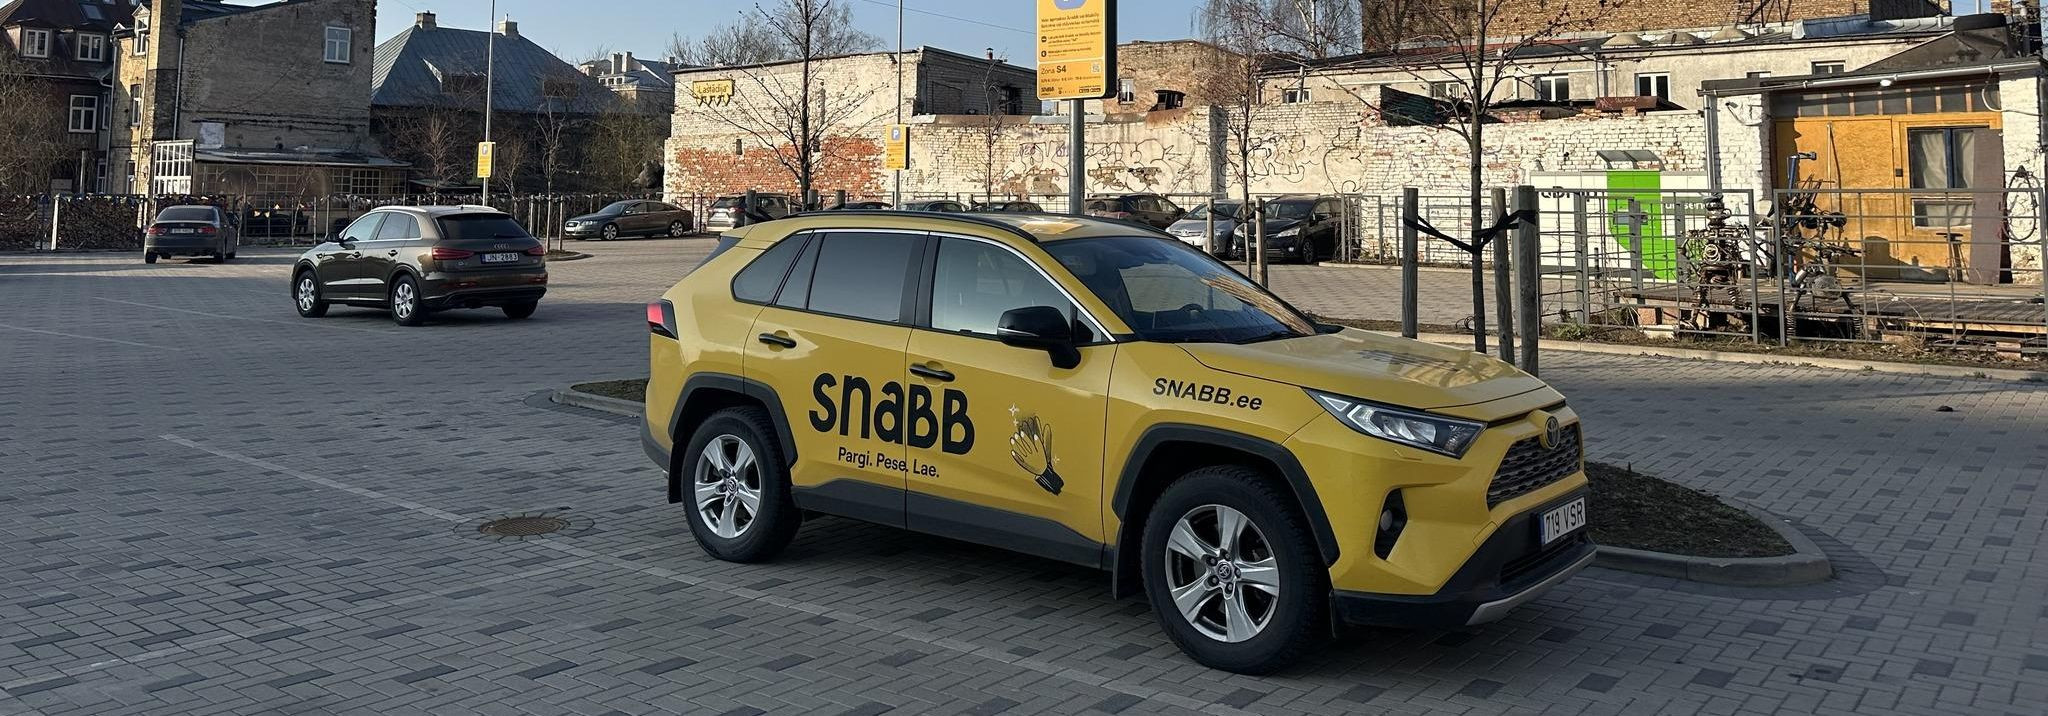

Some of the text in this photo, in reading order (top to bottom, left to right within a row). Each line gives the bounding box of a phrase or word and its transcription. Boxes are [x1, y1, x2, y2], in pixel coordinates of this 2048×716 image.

[1056, 65, 1067, 73] S4
[1153, 378, 1262, 410] SNABB.ee
[838, 447, 940, 477] Pargi. Pese. Lae.
[1546, 501, 1584, 540] 719 VSR
